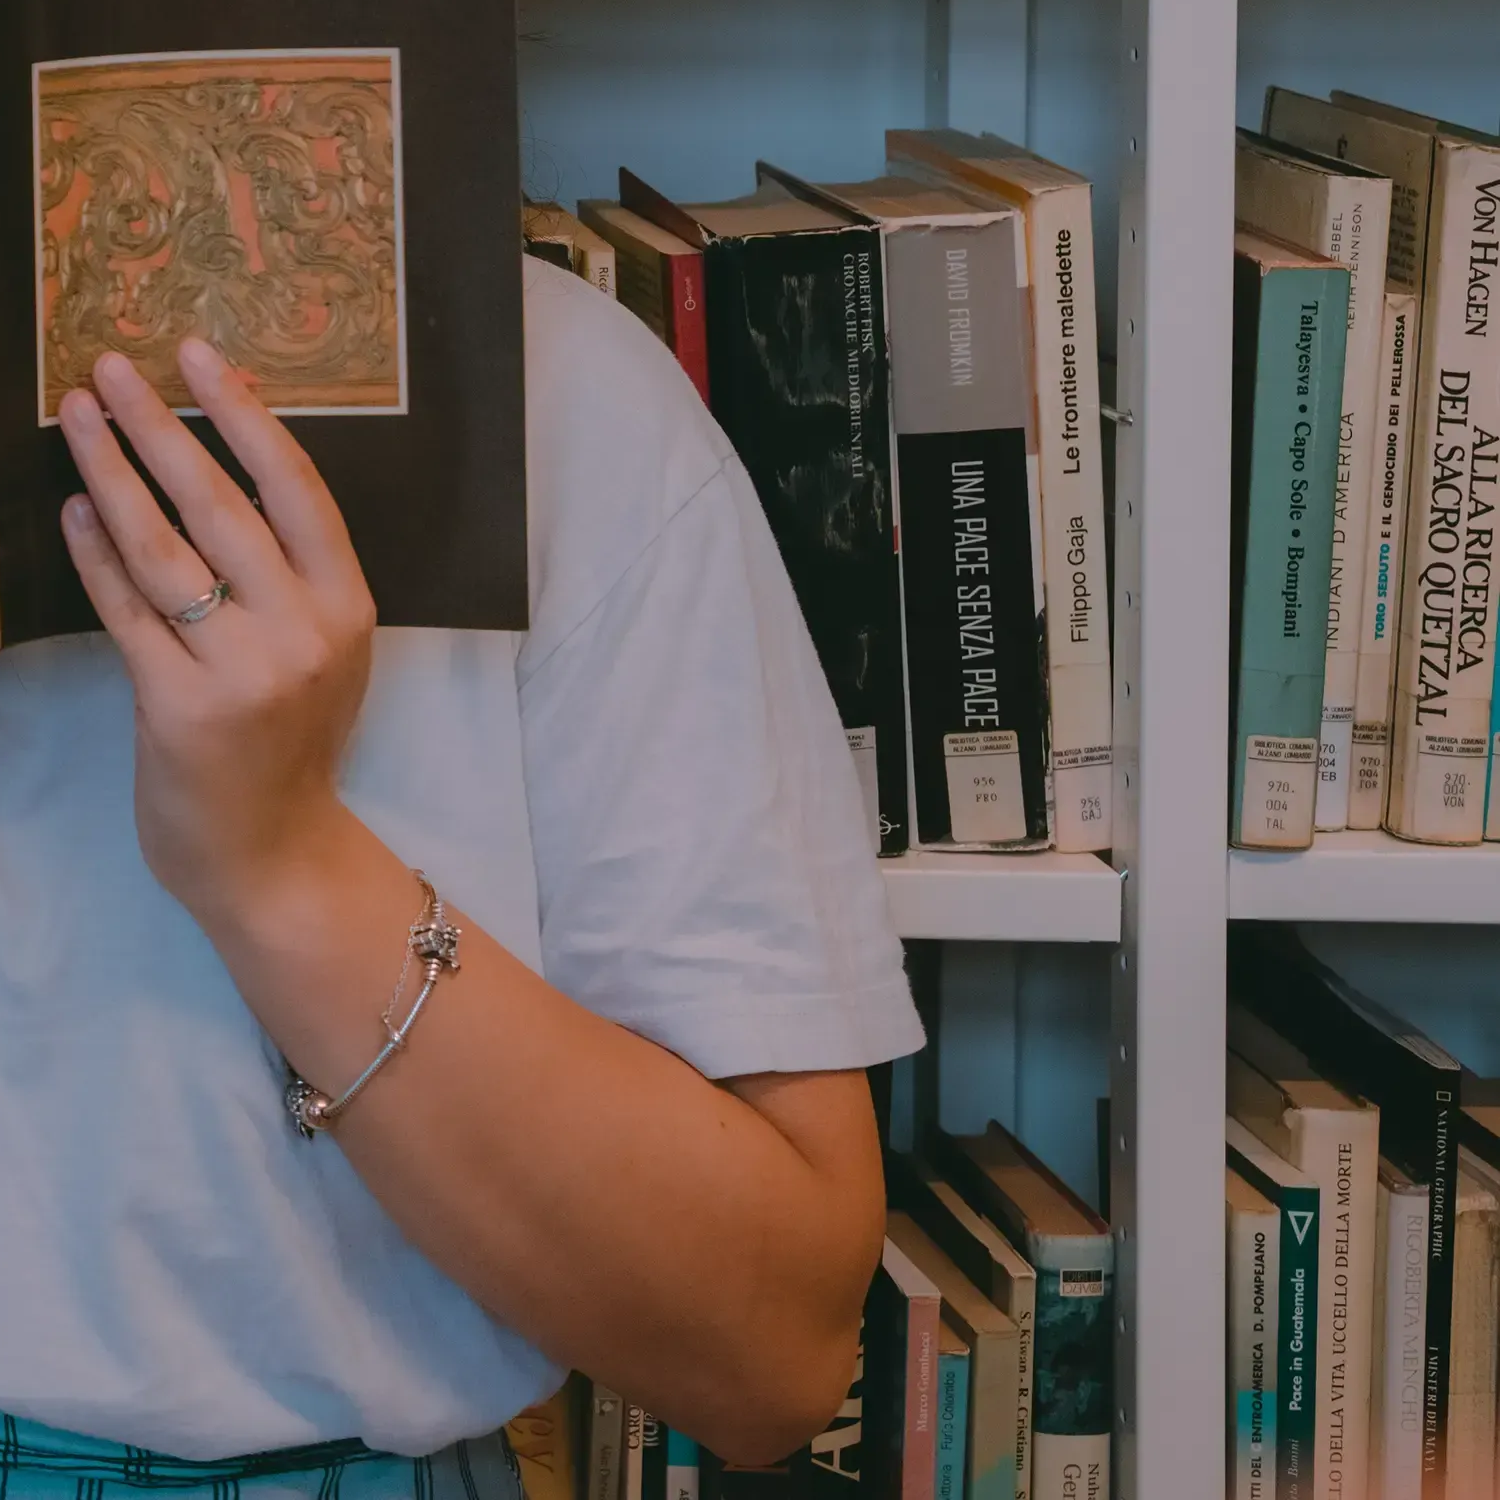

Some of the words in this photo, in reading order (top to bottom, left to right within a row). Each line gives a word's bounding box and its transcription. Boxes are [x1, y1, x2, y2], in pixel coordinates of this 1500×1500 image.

[1056, 229, 1079, 339] maledette
[1292, 301, 1319, 396] Talayesva
[1061, 344, 1081, 440] frontiere
[1435, 369, 1470, 437] DEL
[1063, 445, 1083, 475] Le
[1287, 421, 1311, 472] Capo
[951, 460, 985, 510] UNA
[1288, 479, 1308, 521] Sole
[1426, 442, 1464, 555] SACRO
[953, 517, 990, 575] PACE
[1067, 515, 1087, 566] Gaja
[956, 585, 994, 660] SENZA
[1068, 572, 1091, 644] Filippo
[1281, 545, 1305, 639] Bompiani
[1415, 562, 1455, 728] QUETZAL
[963, 668, 1000, 727] PACE
[1337, 1143, 1353, 1207] MORTE
[1335, 1212, 1351, 1269] DELLA
[1290, 1268, 1307, 1352] Guatemala
[1333, 1274, 1349, 1354] UCCELLO
[1288, 1375, 1305, 1411] Pace
[1290, 1357, 1303, 1371] in
[1329, 1408, 1345, 1464] DELLA
